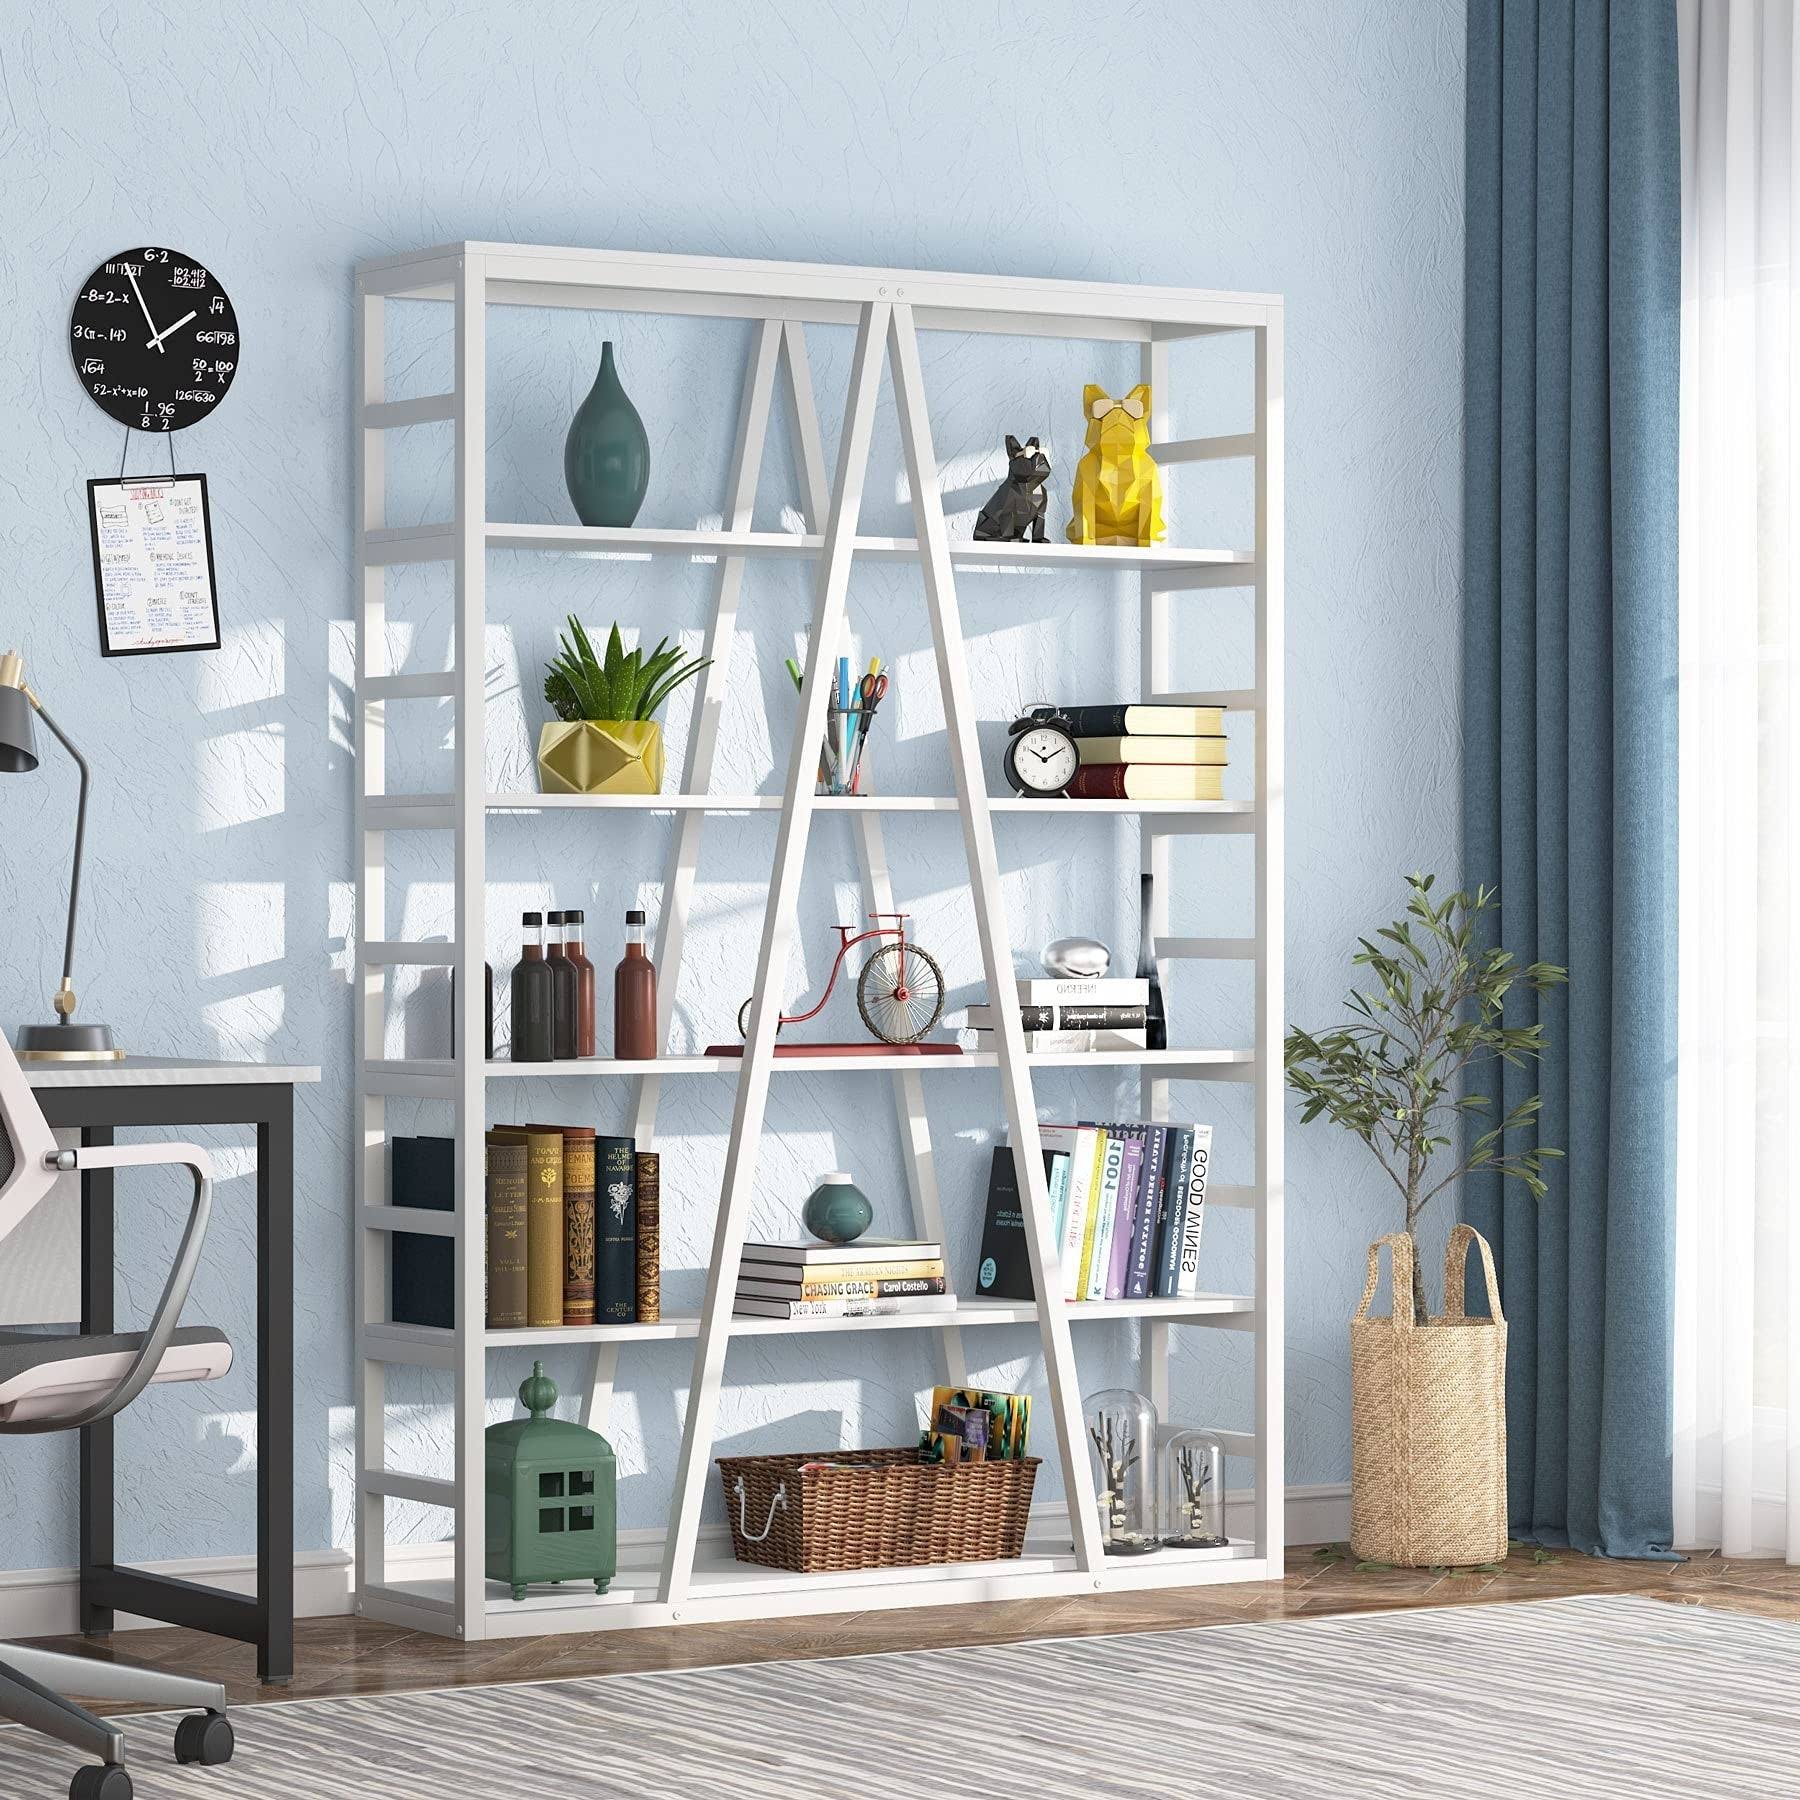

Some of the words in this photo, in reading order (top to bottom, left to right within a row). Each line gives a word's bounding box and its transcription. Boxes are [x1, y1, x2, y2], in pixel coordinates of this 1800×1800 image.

[566, 1174, 595, 1184] POEMS
[804, 1283, 844, 1297] CHASING
[845, 1281, 874, 1295] GRACE
[884, 1282, 901, 1292] Carol
[902, 1281, 929, 1292] Costello
[792, 1302, 808, 1316] New
[810, 1300, 827, 1315] York
